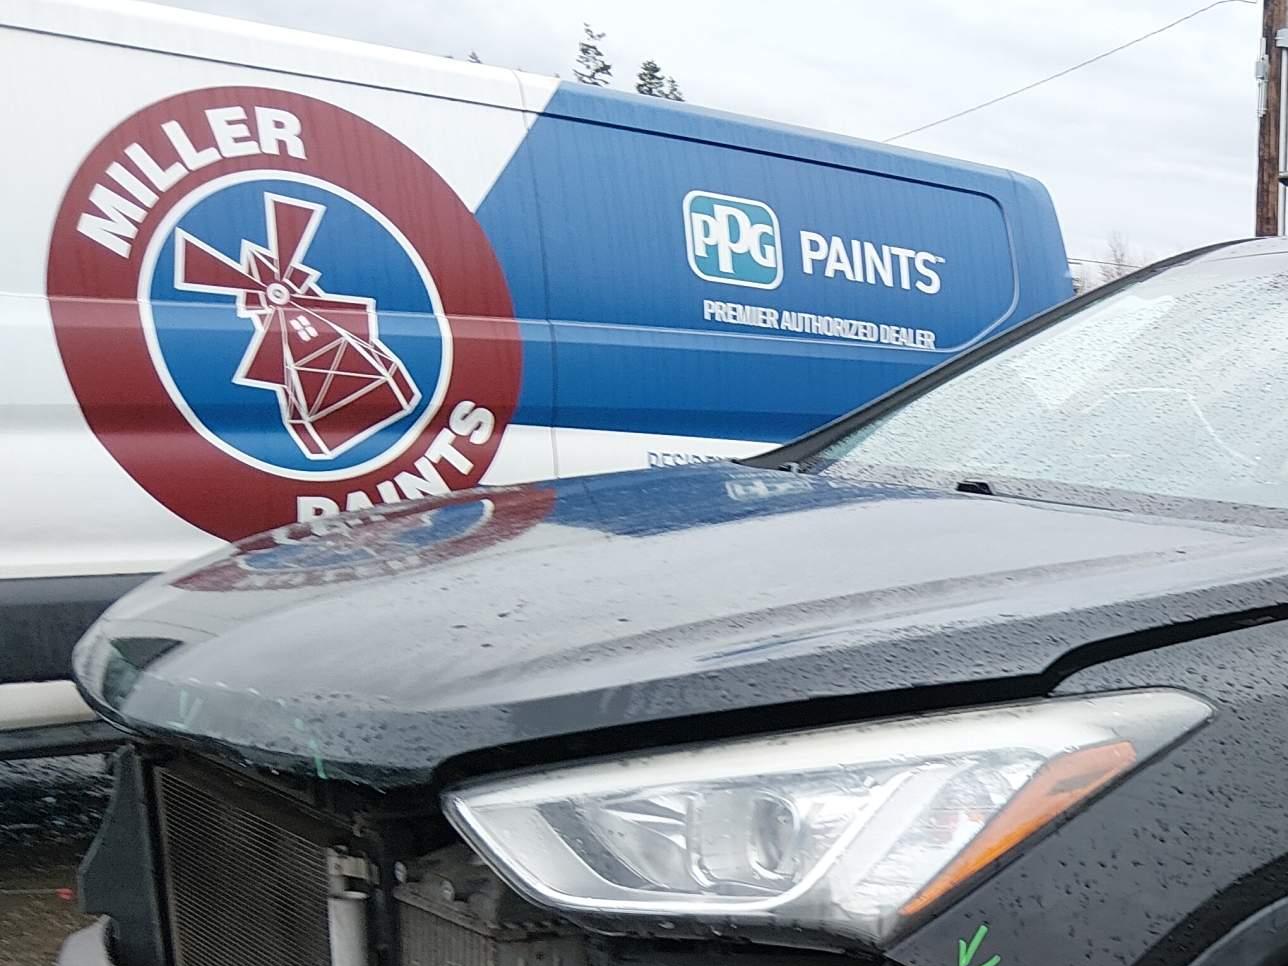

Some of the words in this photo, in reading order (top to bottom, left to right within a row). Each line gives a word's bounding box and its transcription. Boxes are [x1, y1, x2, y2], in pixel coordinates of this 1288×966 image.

[76, 105, 307, 259] MILLER
[690, 203, 777, 274] PPG
[799, 230, 942, 295] PAINTS
[703, 299, 779, 329] PREMIER
[780, 310, 878, 342] AUTHORIZED
[879, 324, 936, 351] DEALER
